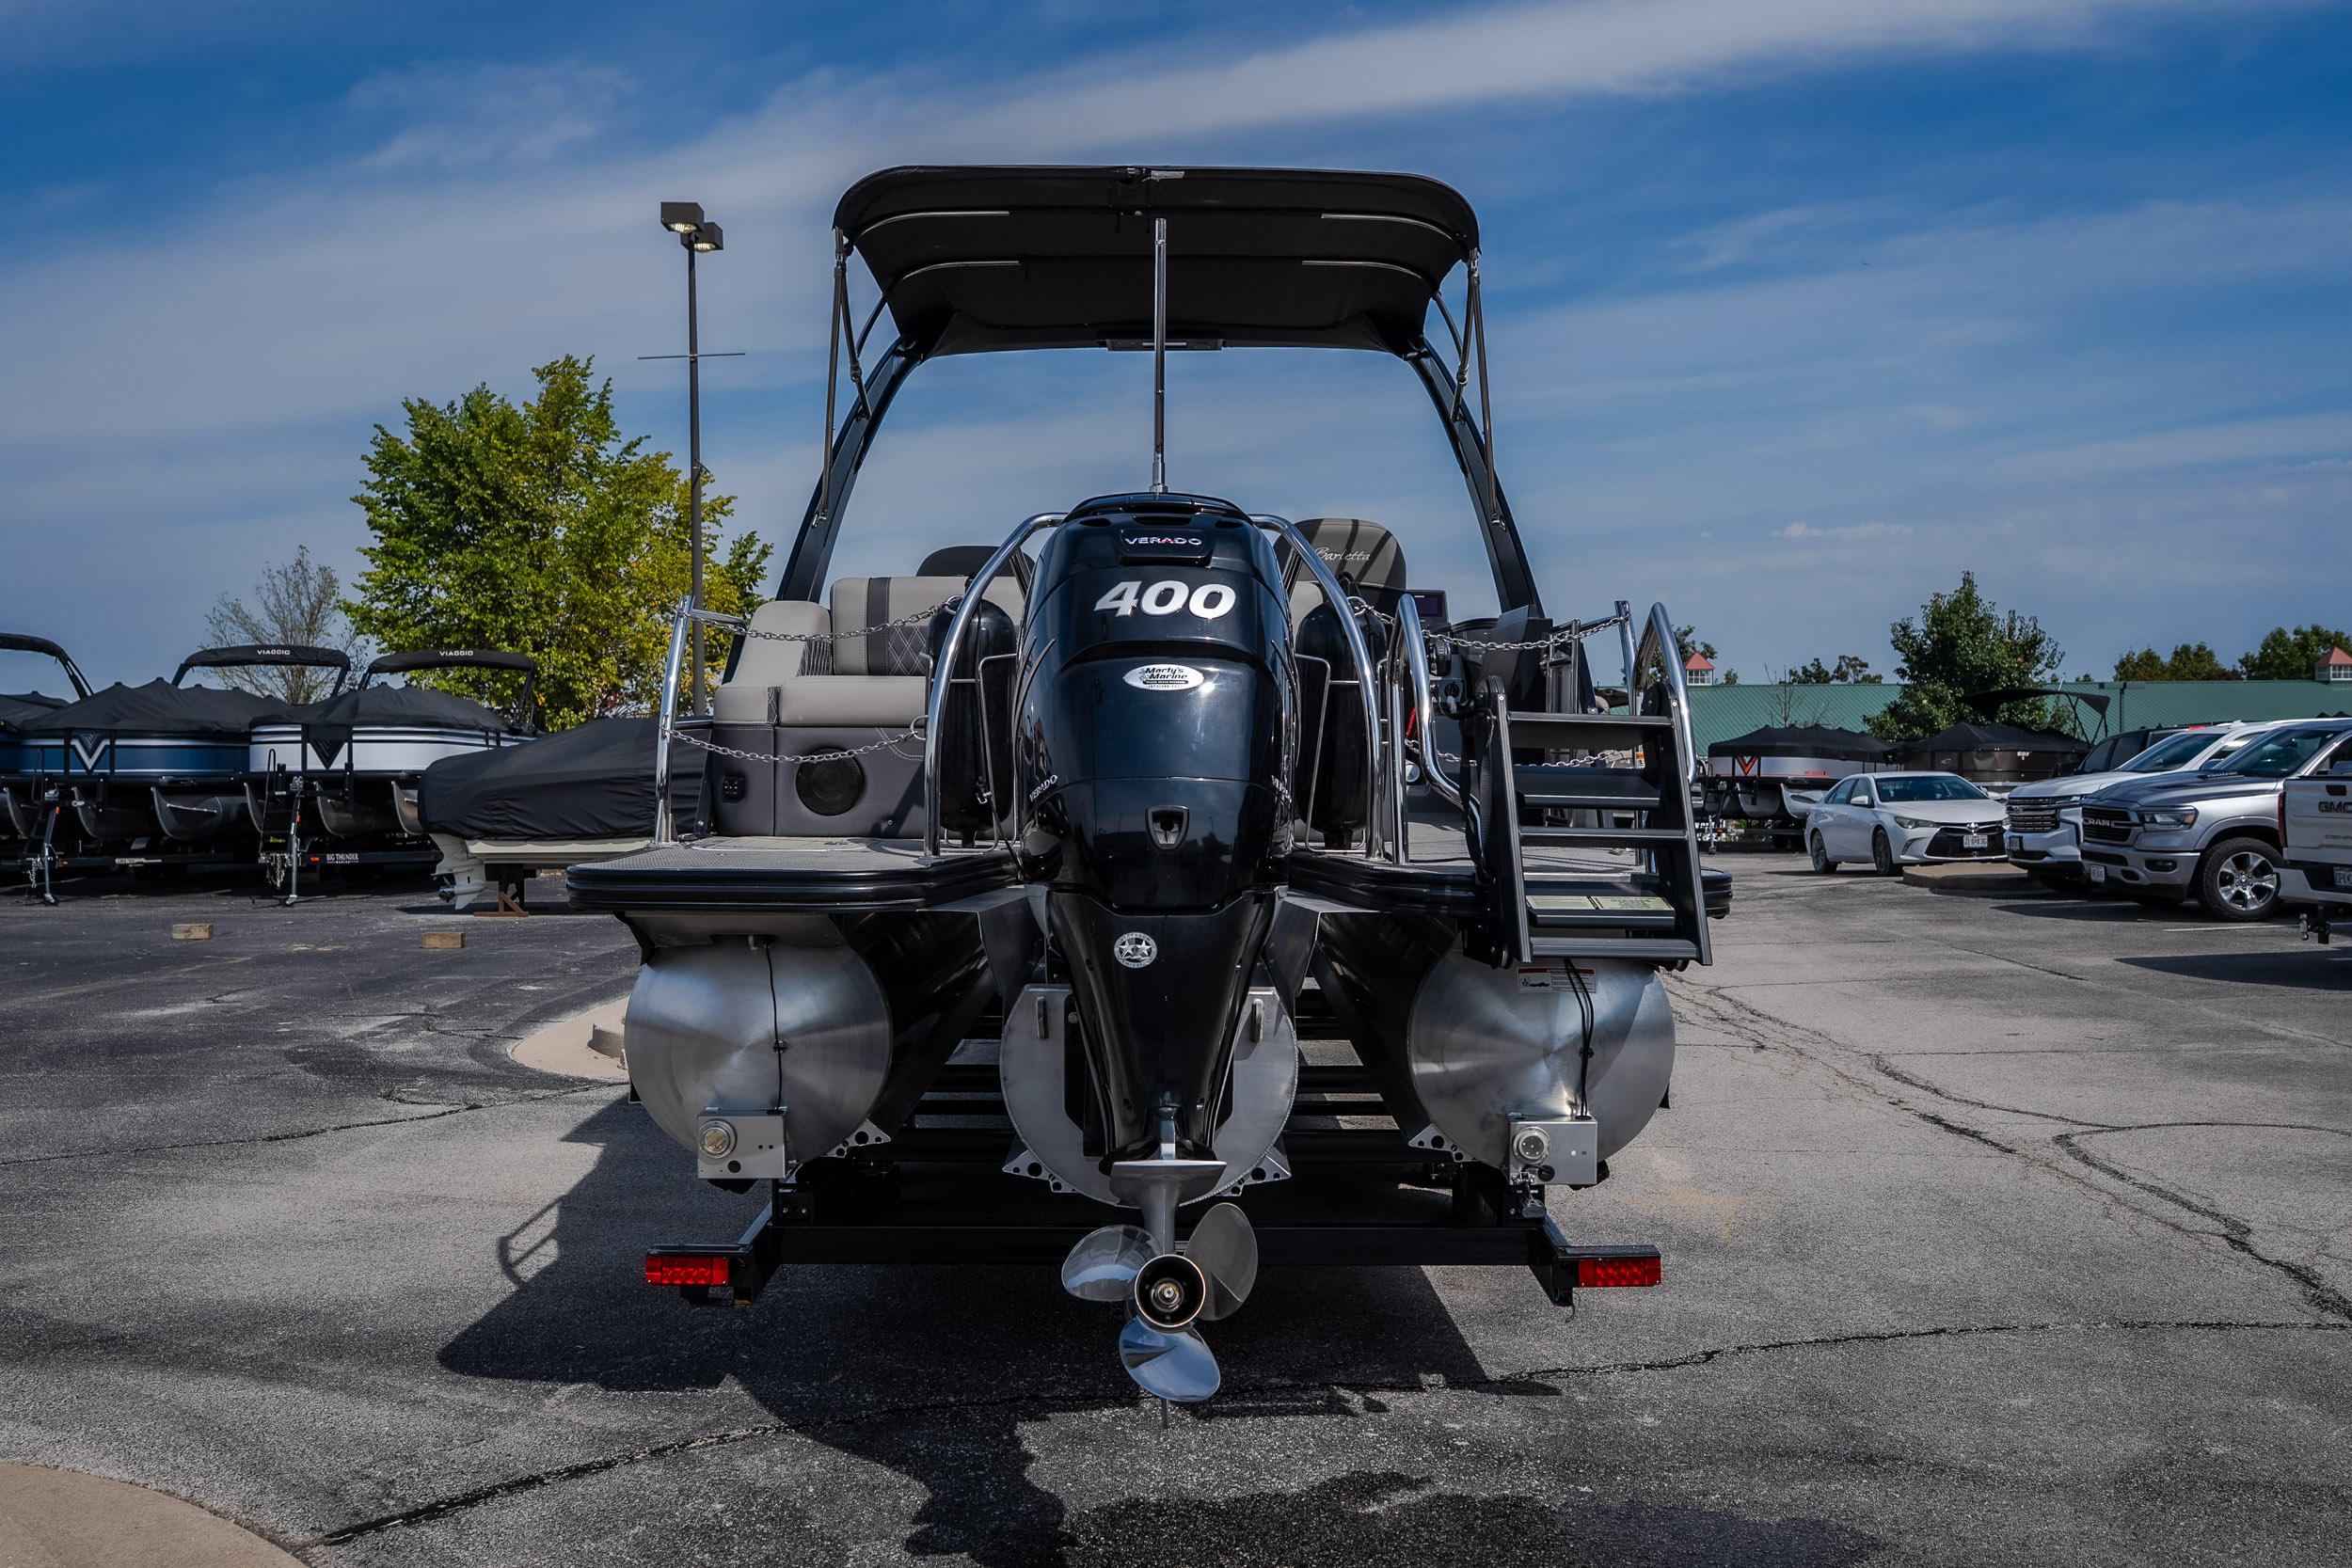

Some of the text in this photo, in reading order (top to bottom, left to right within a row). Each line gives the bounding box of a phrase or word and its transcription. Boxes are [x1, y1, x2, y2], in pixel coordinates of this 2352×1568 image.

[1124, 536, 1202, 546] VERADO
[1314, 546, 1371, 561] Barletta
[1093, 579, 1236, 620] 400
[2318, 800, 2352, 814] GMC
[2089, 818, 2110, 827] RAM
